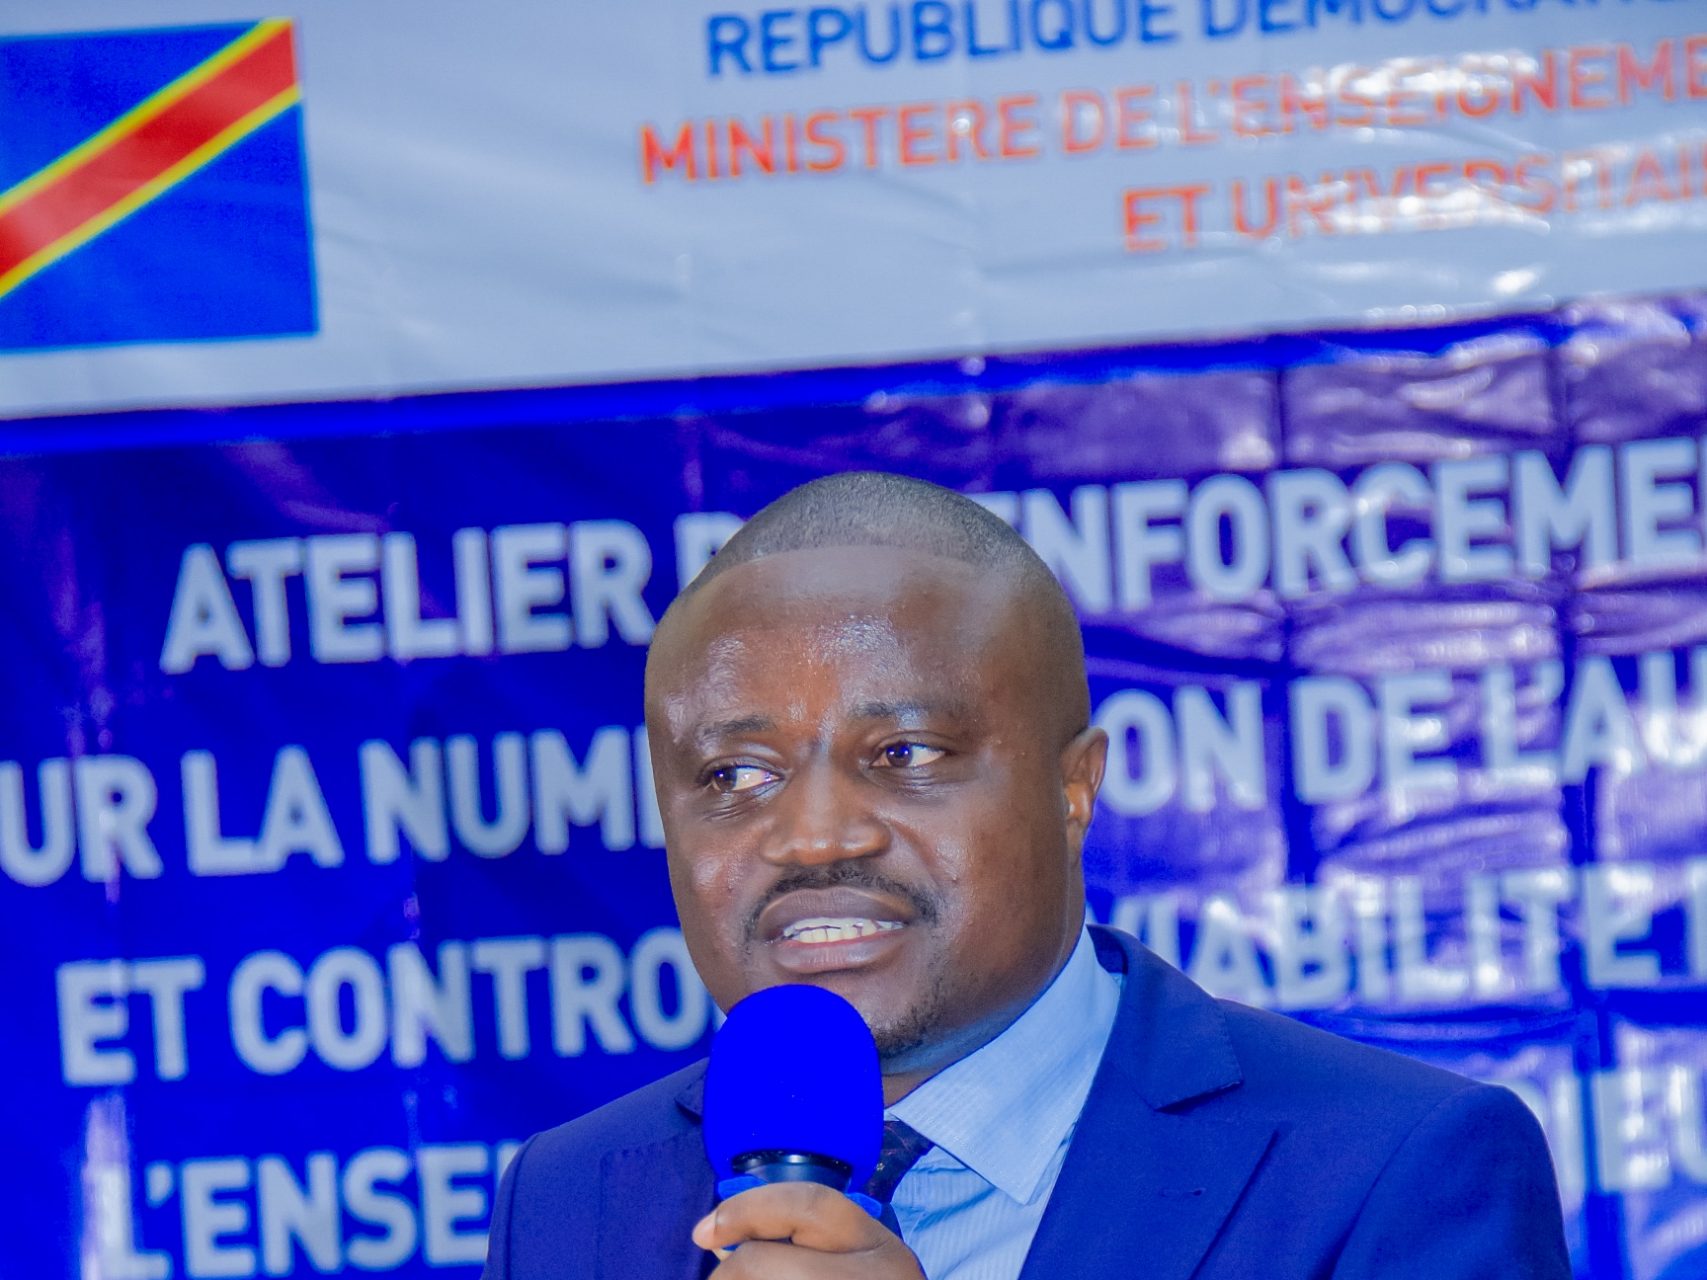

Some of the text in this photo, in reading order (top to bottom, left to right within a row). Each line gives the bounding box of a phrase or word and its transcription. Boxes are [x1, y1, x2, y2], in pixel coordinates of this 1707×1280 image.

[706, 0, 1178, 76] REPUBLIQUE
[641, 95, 1040, 184] MINISTERE
[1062, 87, 1158, 154] DE
[1125, 187, 1208, 252] ET
[159, 519, 662, 674] ATELIER
[181, 745, 344, 877] LA
[1290, 671, 1458, 812] DE
[56, 957, 204, 1087] ET
[228, 925, 726, 1077] CONTRO
